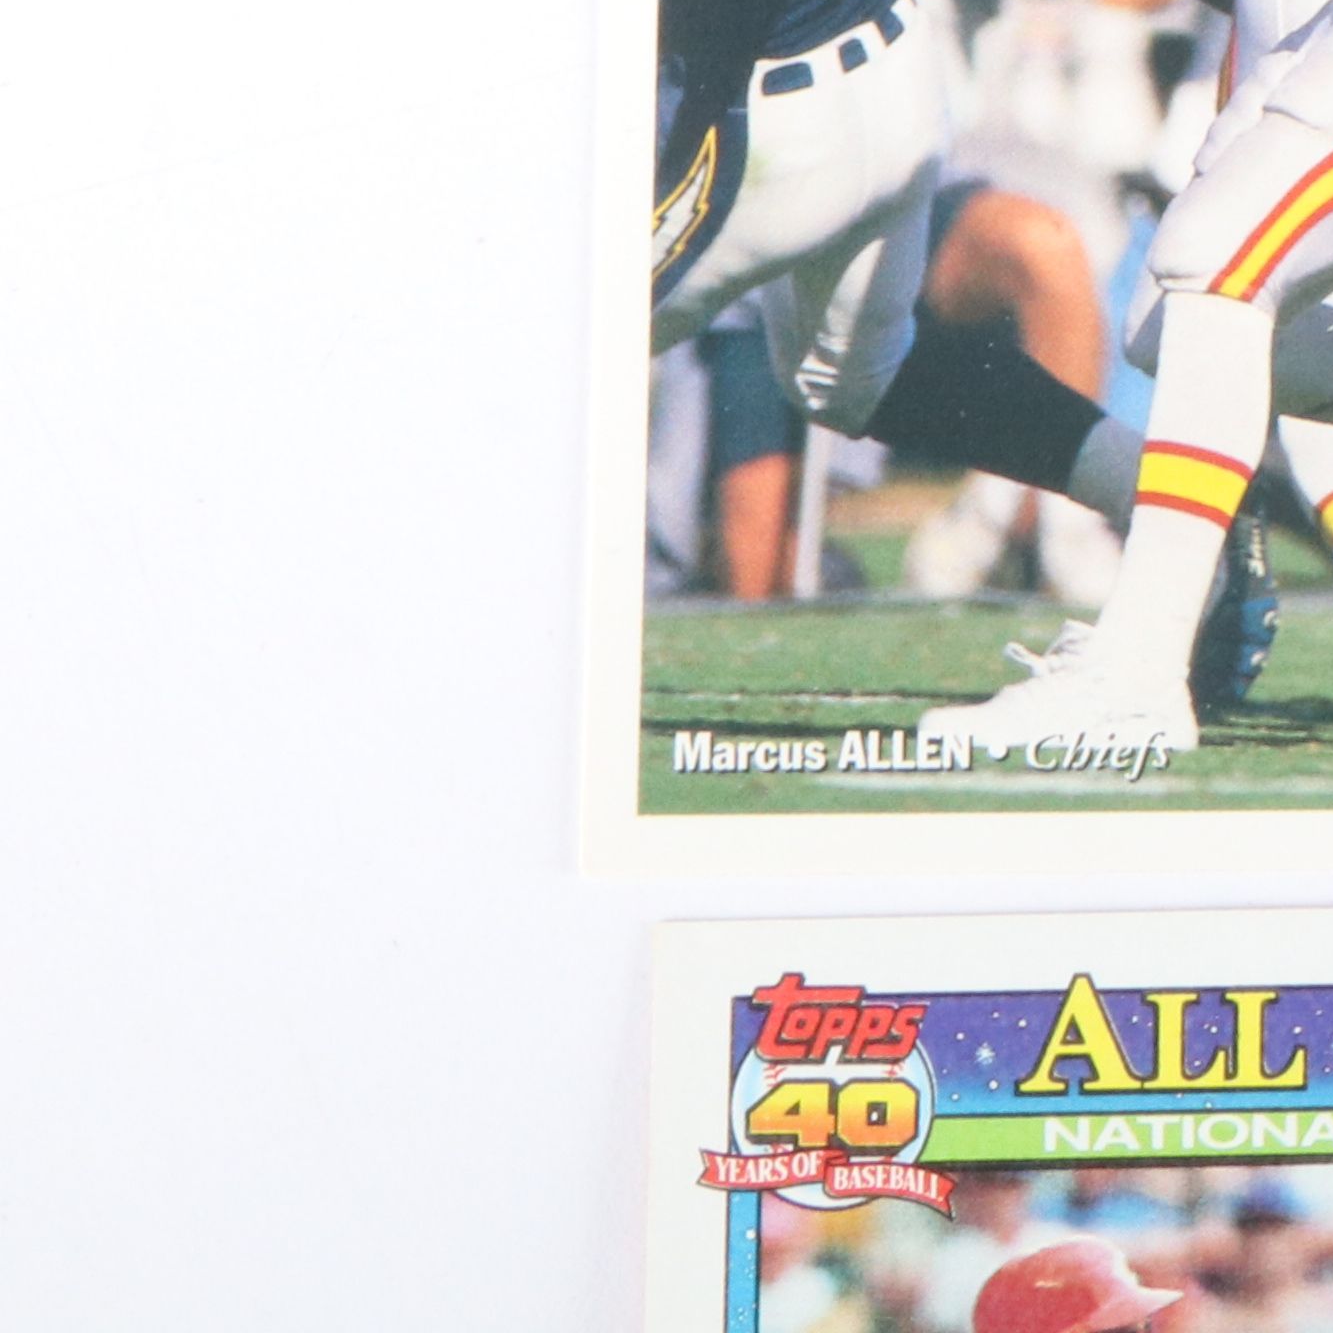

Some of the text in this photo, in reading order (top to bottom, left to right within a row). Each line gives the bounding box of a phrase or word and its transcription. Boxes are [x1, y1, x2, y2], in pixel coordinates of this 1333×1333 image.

[672, 727, 1172, 782] Marcus ALLEN Chiefs
[1014, 972, 1308, 1096] ALL
[745, 1077, 921, 1155] 40
[713, 1151, 946, 1202] YEARS OF BASEBALL
